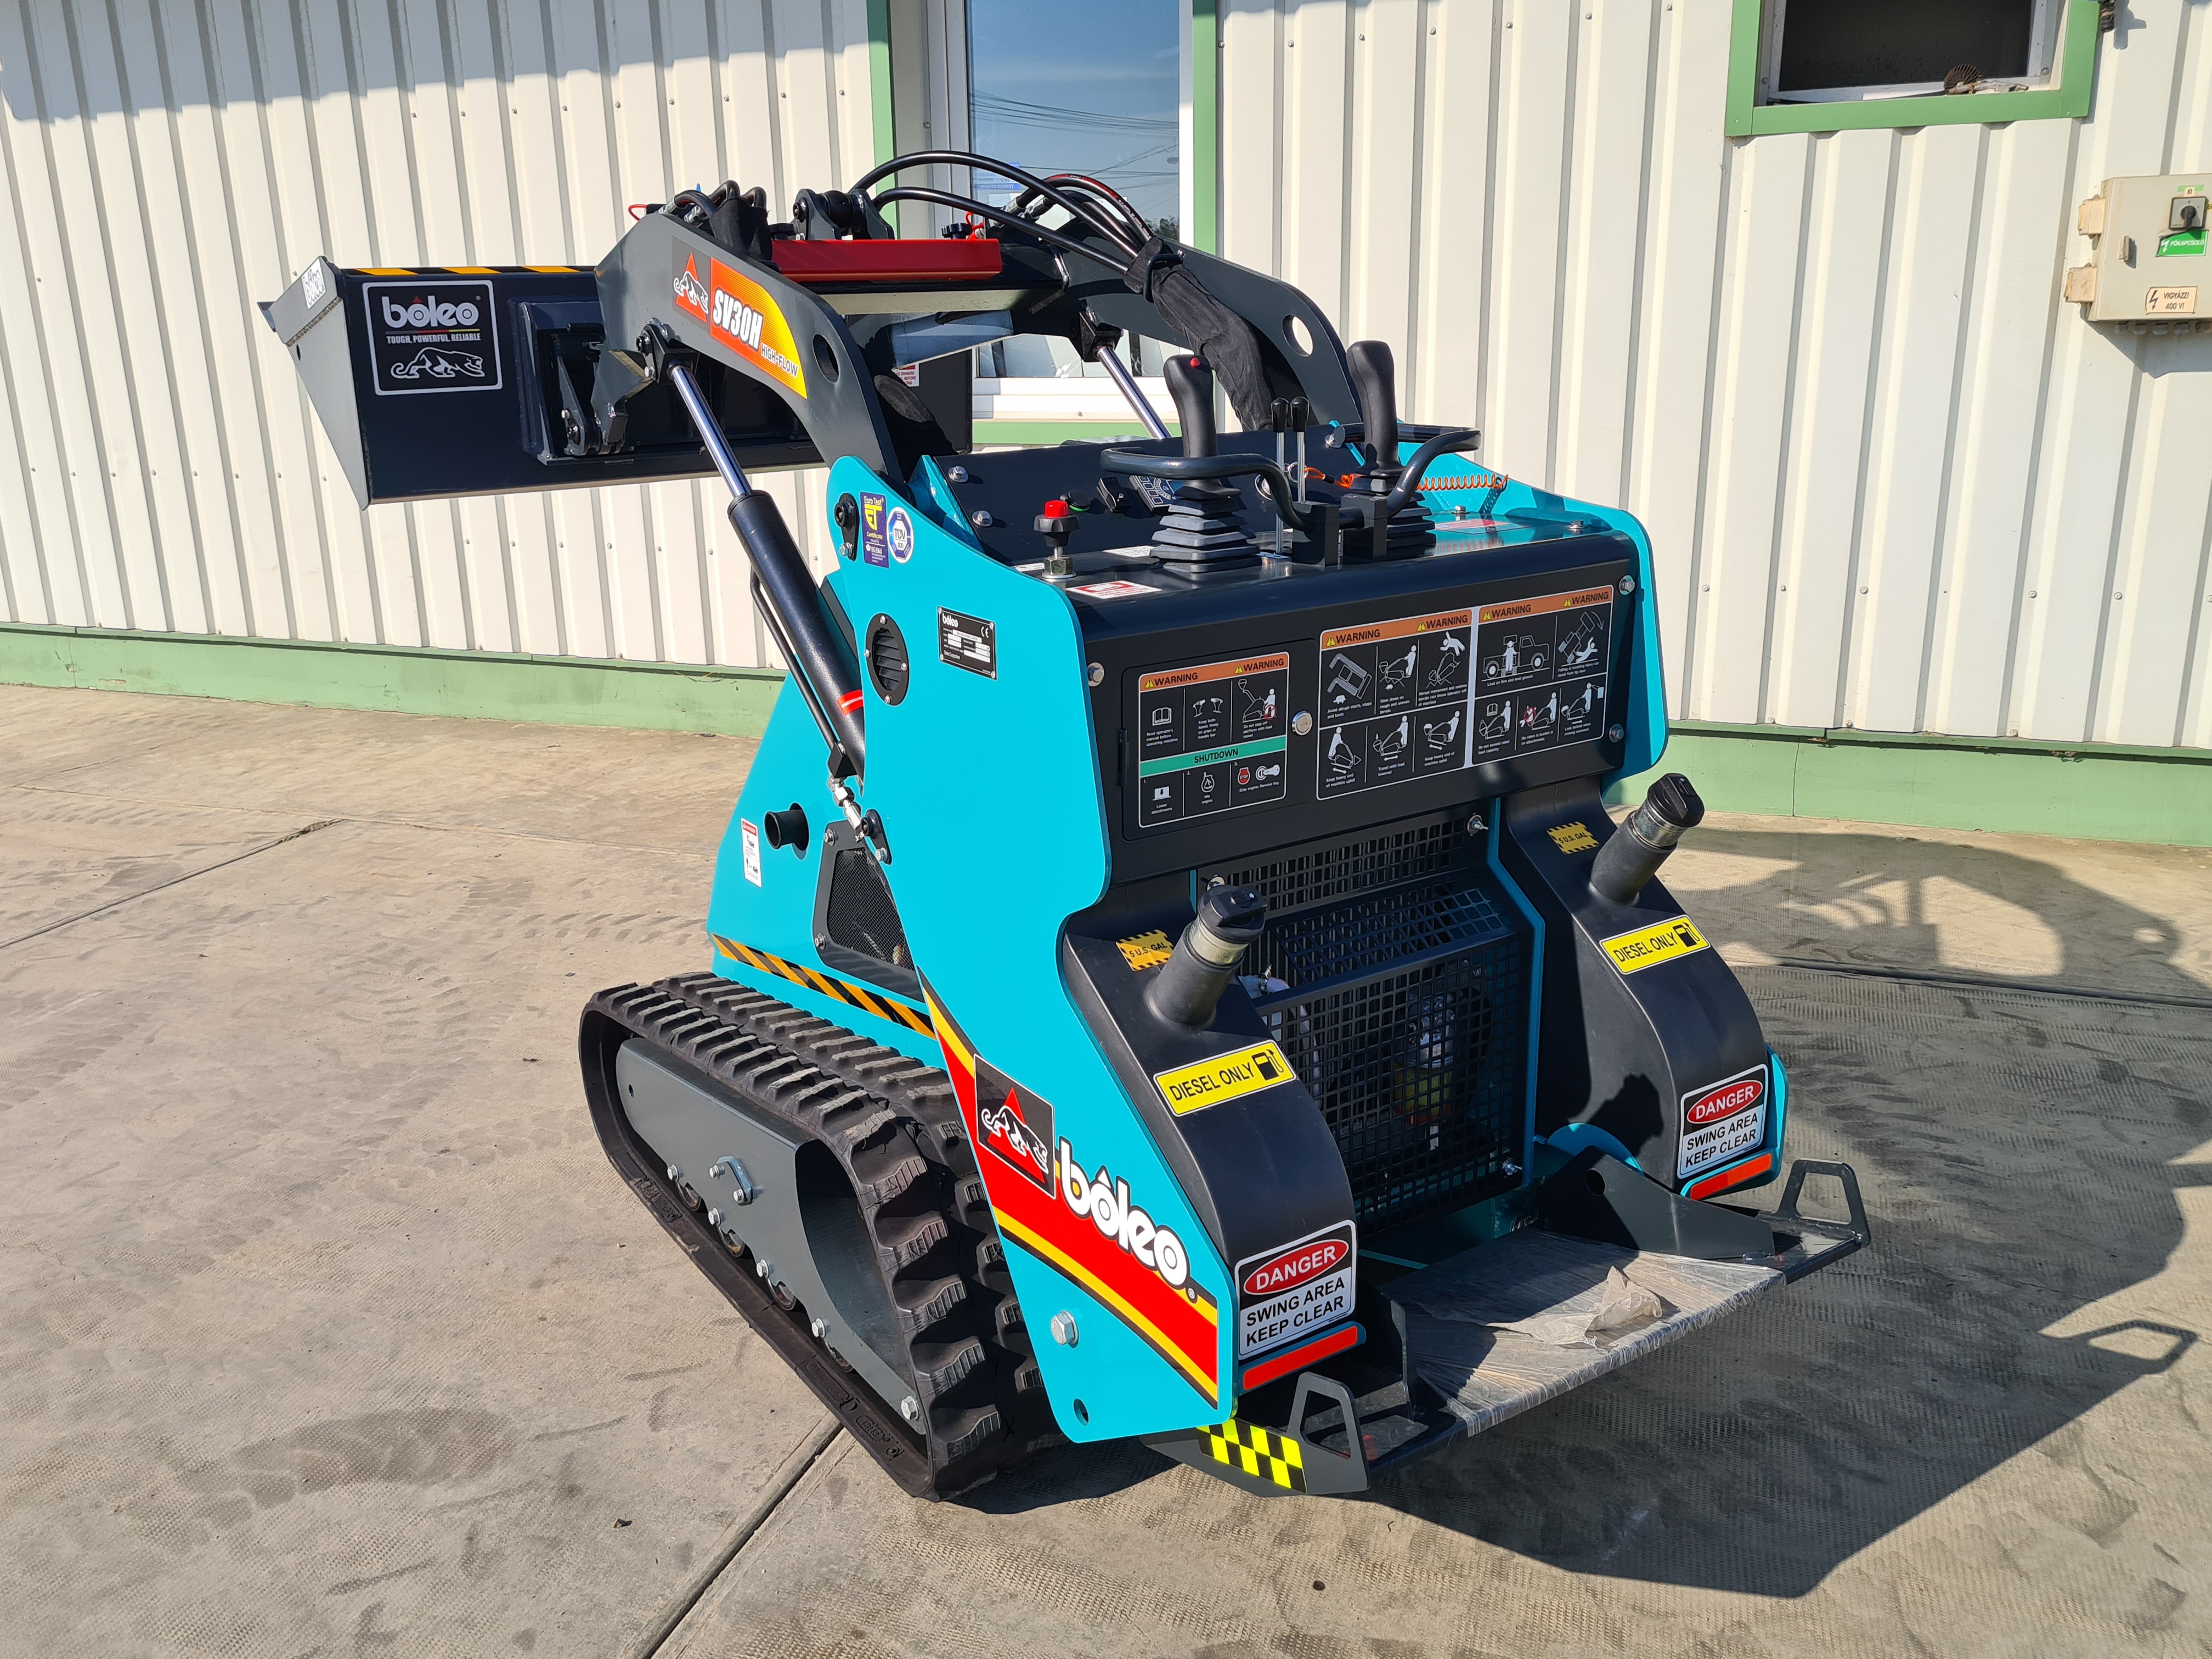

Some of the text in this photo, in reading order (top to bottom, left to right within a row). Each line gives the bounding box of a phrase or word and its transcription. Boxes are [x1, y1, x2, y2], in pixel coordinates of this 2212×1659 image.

[386, 333, 481, 344] TOUGH, POWERFUL, RELIABLE
[713, 289, 799, 377] SV30H HIGH-FLOW
[1491, 591, 1609, 618] WARNING WARNING
[1336, 615, 1468, 644] WARNING WARNING
[1154, 658, 1284, 686] WARNING WARNING
[1194, 748, 1238, 764] SHUTDOWN
[1135, 946, 1151, 956] U.S.
[1150, 942, 1168, 951] GAL
[1613, 932, 1678, 962] DIESEL ONLY
[1169, 1062, 1255, 1102] DIESEL ONLY
[1696, 1085, 1754, 1120] DANGER
[1685, 1129, 1756, 1168] KEEP CLEAR
[1687, 1113, 1758, 1150] SWING AREA
[1256, 1245, 1336, 1291] DANGER
[1246, 1277, 1345, 1327] SWING AREA
[1246, 1295, 1344, 1347] KEEP CLEAR
